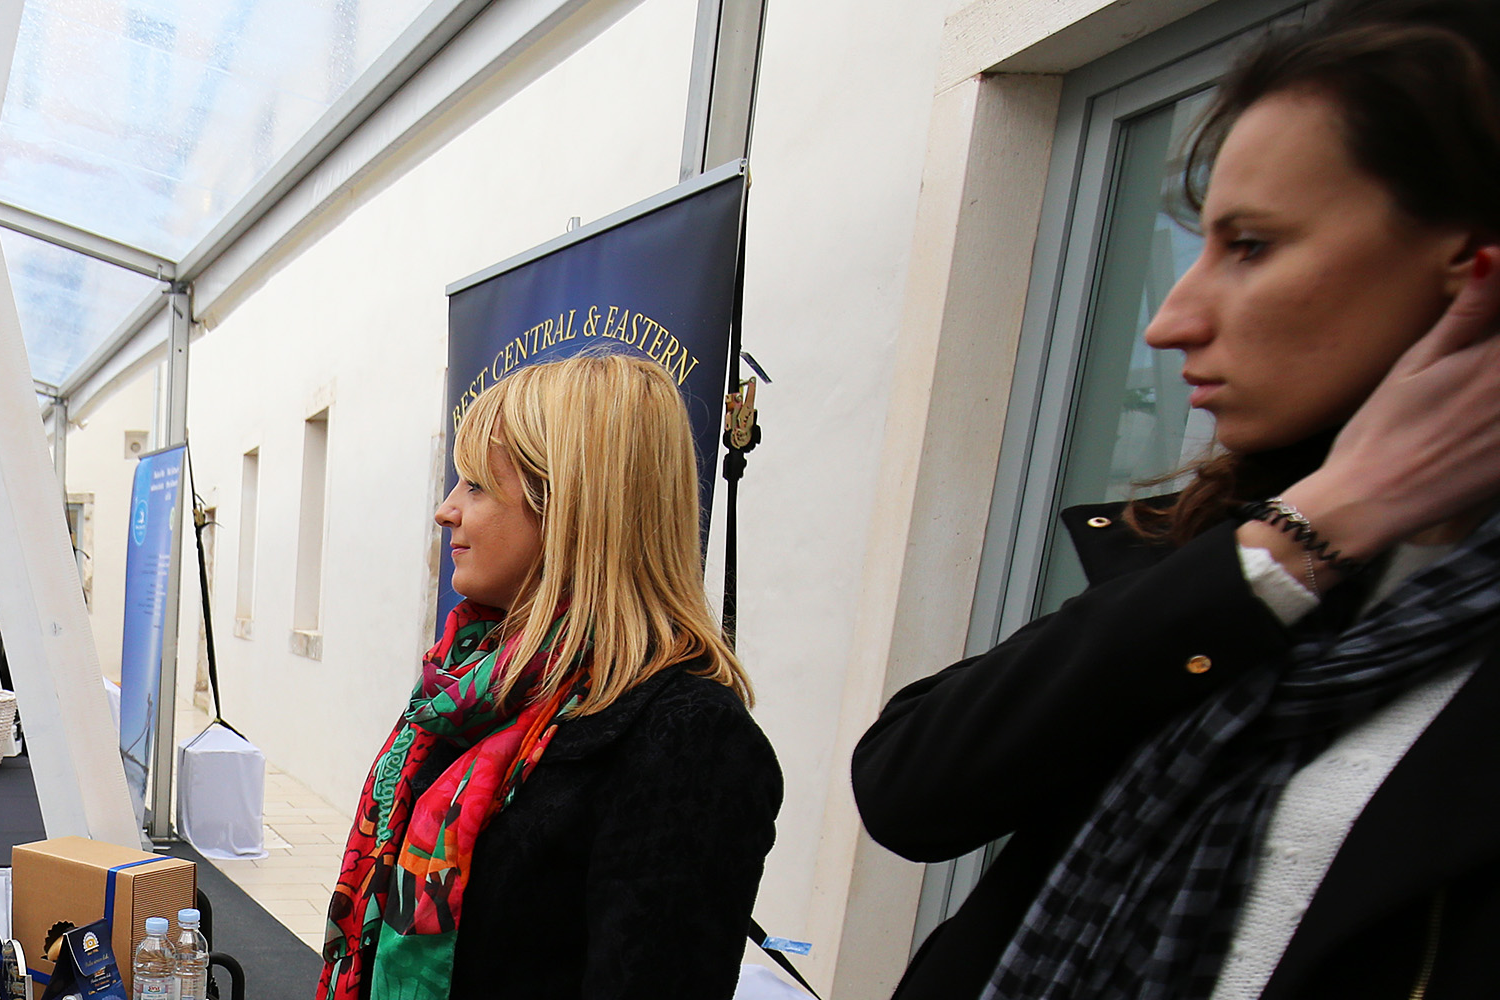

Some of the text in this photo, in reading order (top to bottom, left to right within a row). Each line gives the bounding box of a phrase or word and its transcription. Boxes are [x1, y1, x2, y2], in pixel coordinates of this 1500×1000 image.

[492, 308, 578, 379] CENTRAL
[583, 304, 601, 338] &
[602, 305, 700, 387] EASTERN
